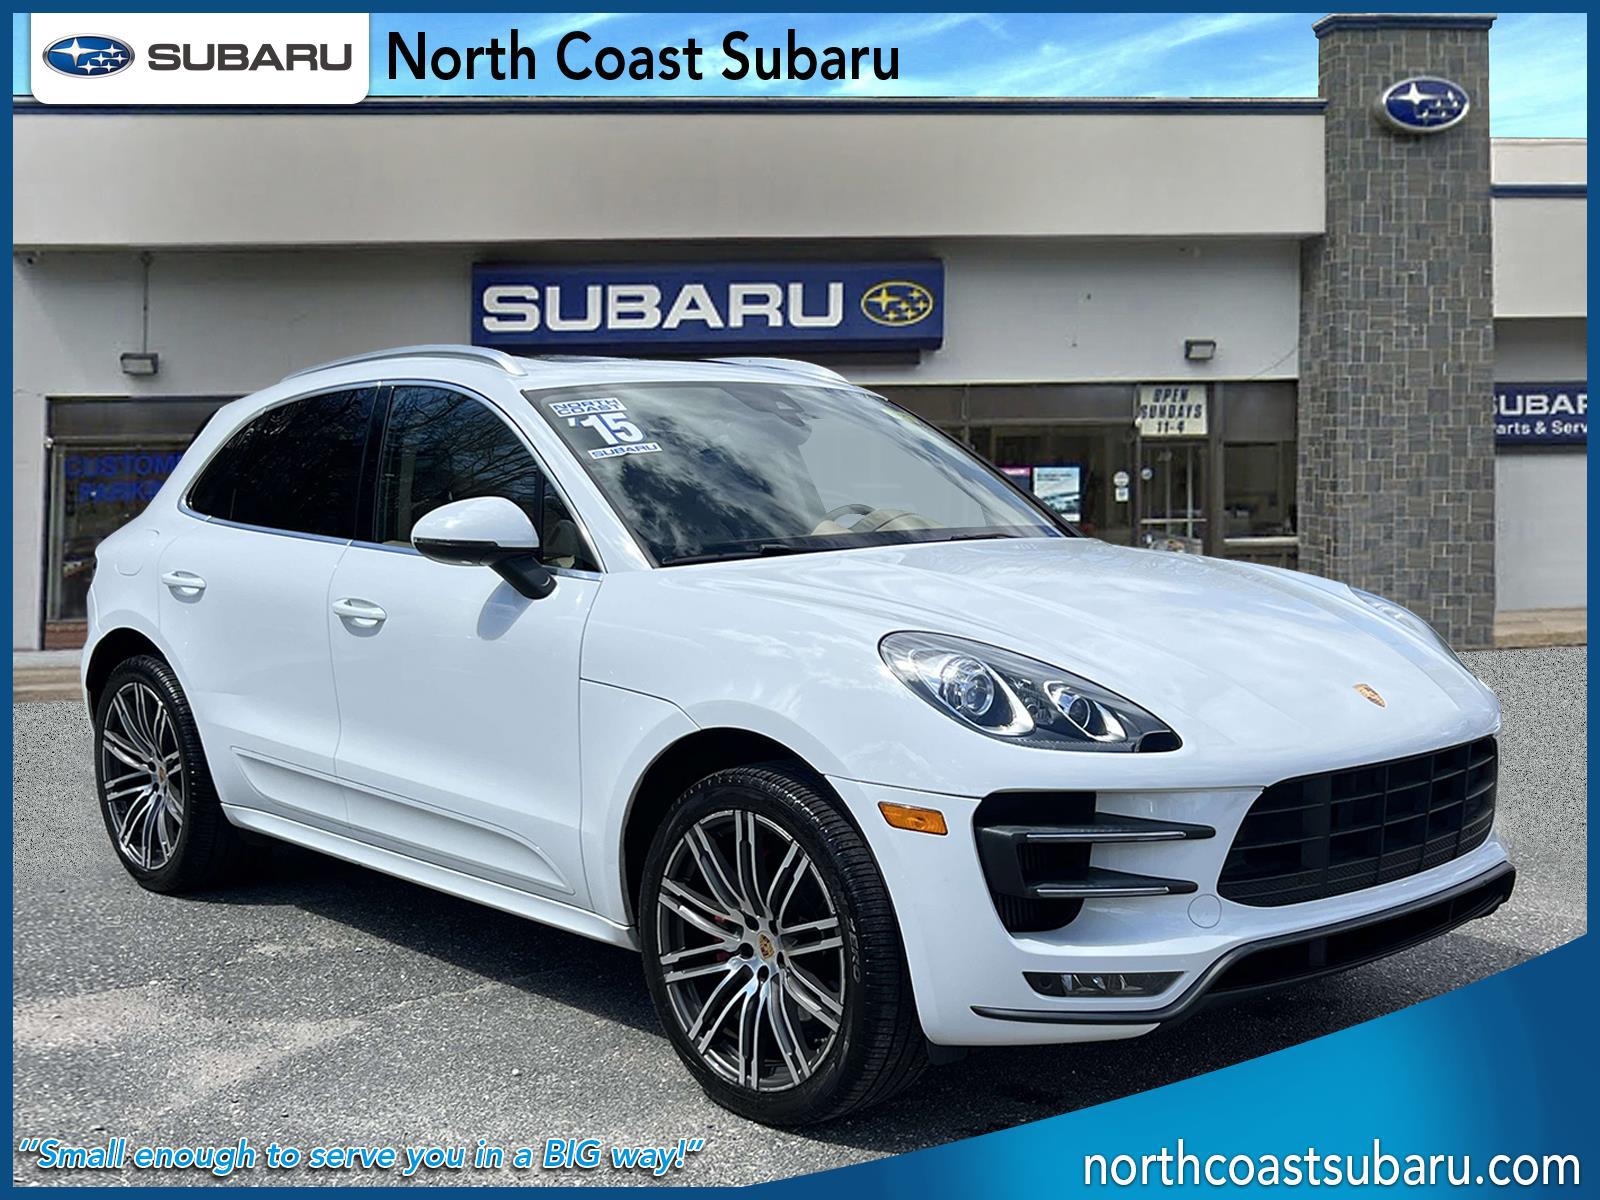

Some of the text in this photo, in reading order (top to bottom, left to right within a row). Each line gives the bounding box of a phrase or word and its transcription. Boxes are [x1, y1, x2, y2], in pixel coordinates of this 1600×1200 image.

[482, 281, 844, 332] SUBARU
[1153, 388, 1190, 403] OPEN
[553, 399, 622, 410] NORTH
[557, 404, 623, 416] COAST
[1140, 404, 1202, 419] SUNDAYS
[1493, 394, 1587, 416] UBA
[567, 412, 645, 445] '15
[1534, 420, 1547, 435] &
[591, 444, 658, 458] SUBARU
[65, 453, 182, 477] CUSTOM
